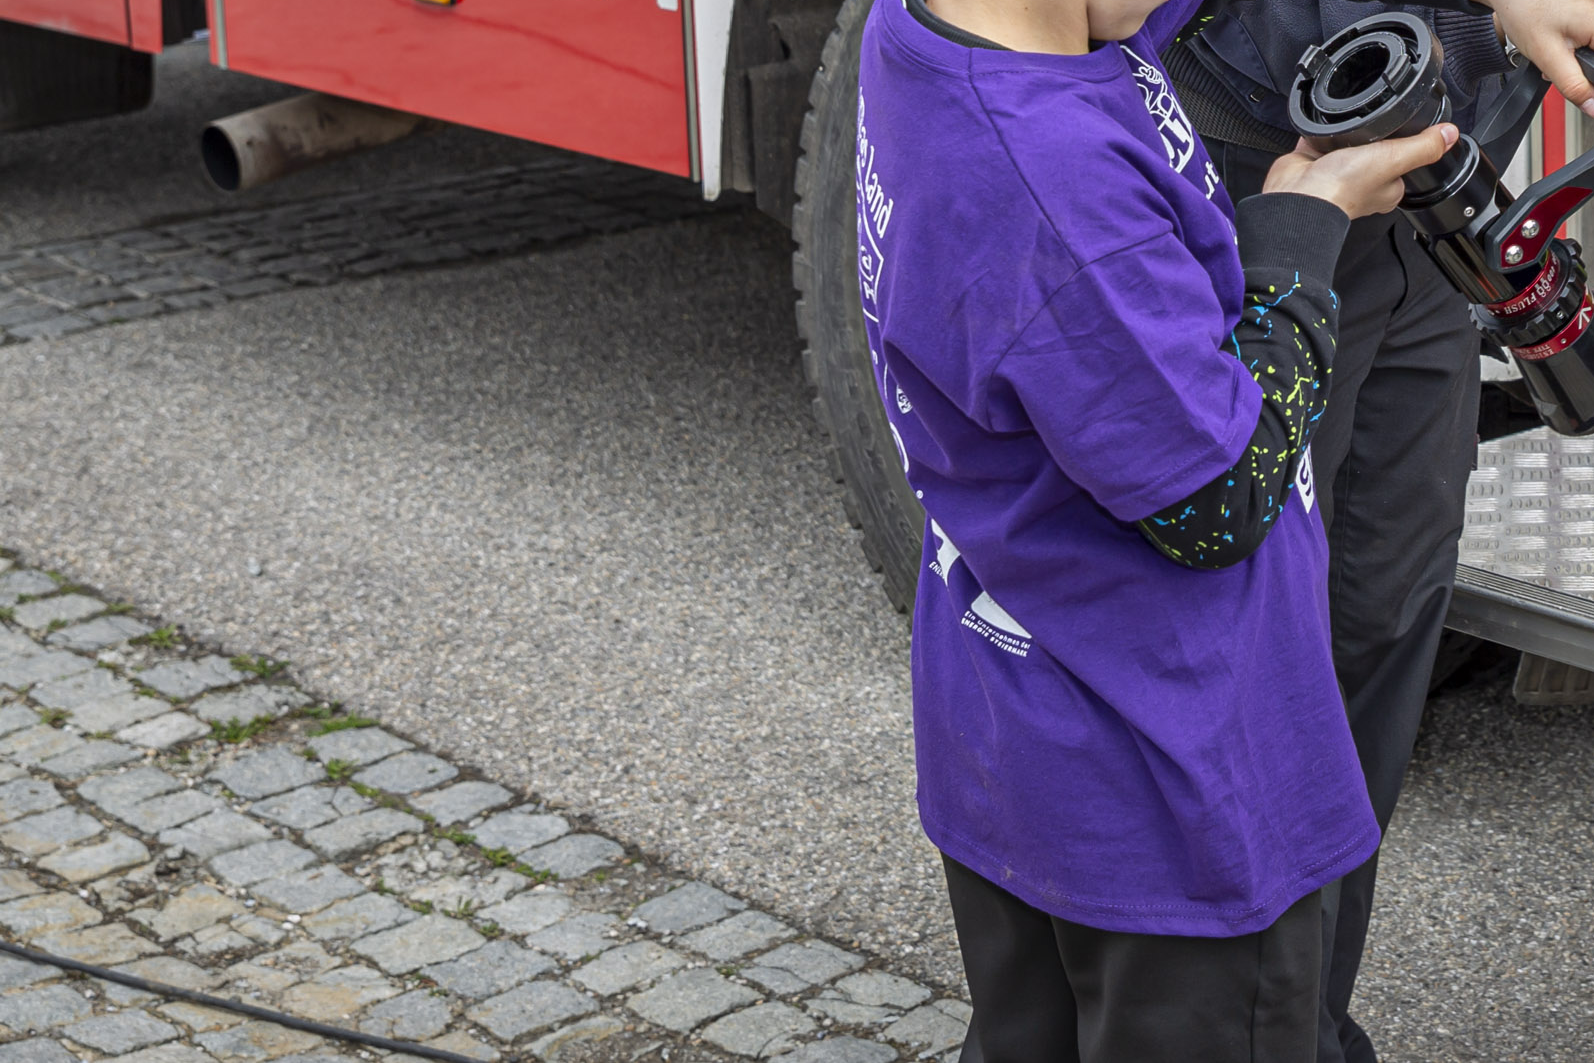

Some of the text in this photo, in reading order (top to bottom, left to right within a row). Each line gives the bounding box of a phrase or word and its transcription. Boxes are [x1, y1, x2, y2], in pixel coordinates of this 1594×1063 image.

[1503, 292, 1537, 315] FLUSH
[961, 617, 1028, 658] ENERGIE STEIERMARK
[964, 610, 977, 622] Ein
[977, 619, 1020, 647] Unternehmen
